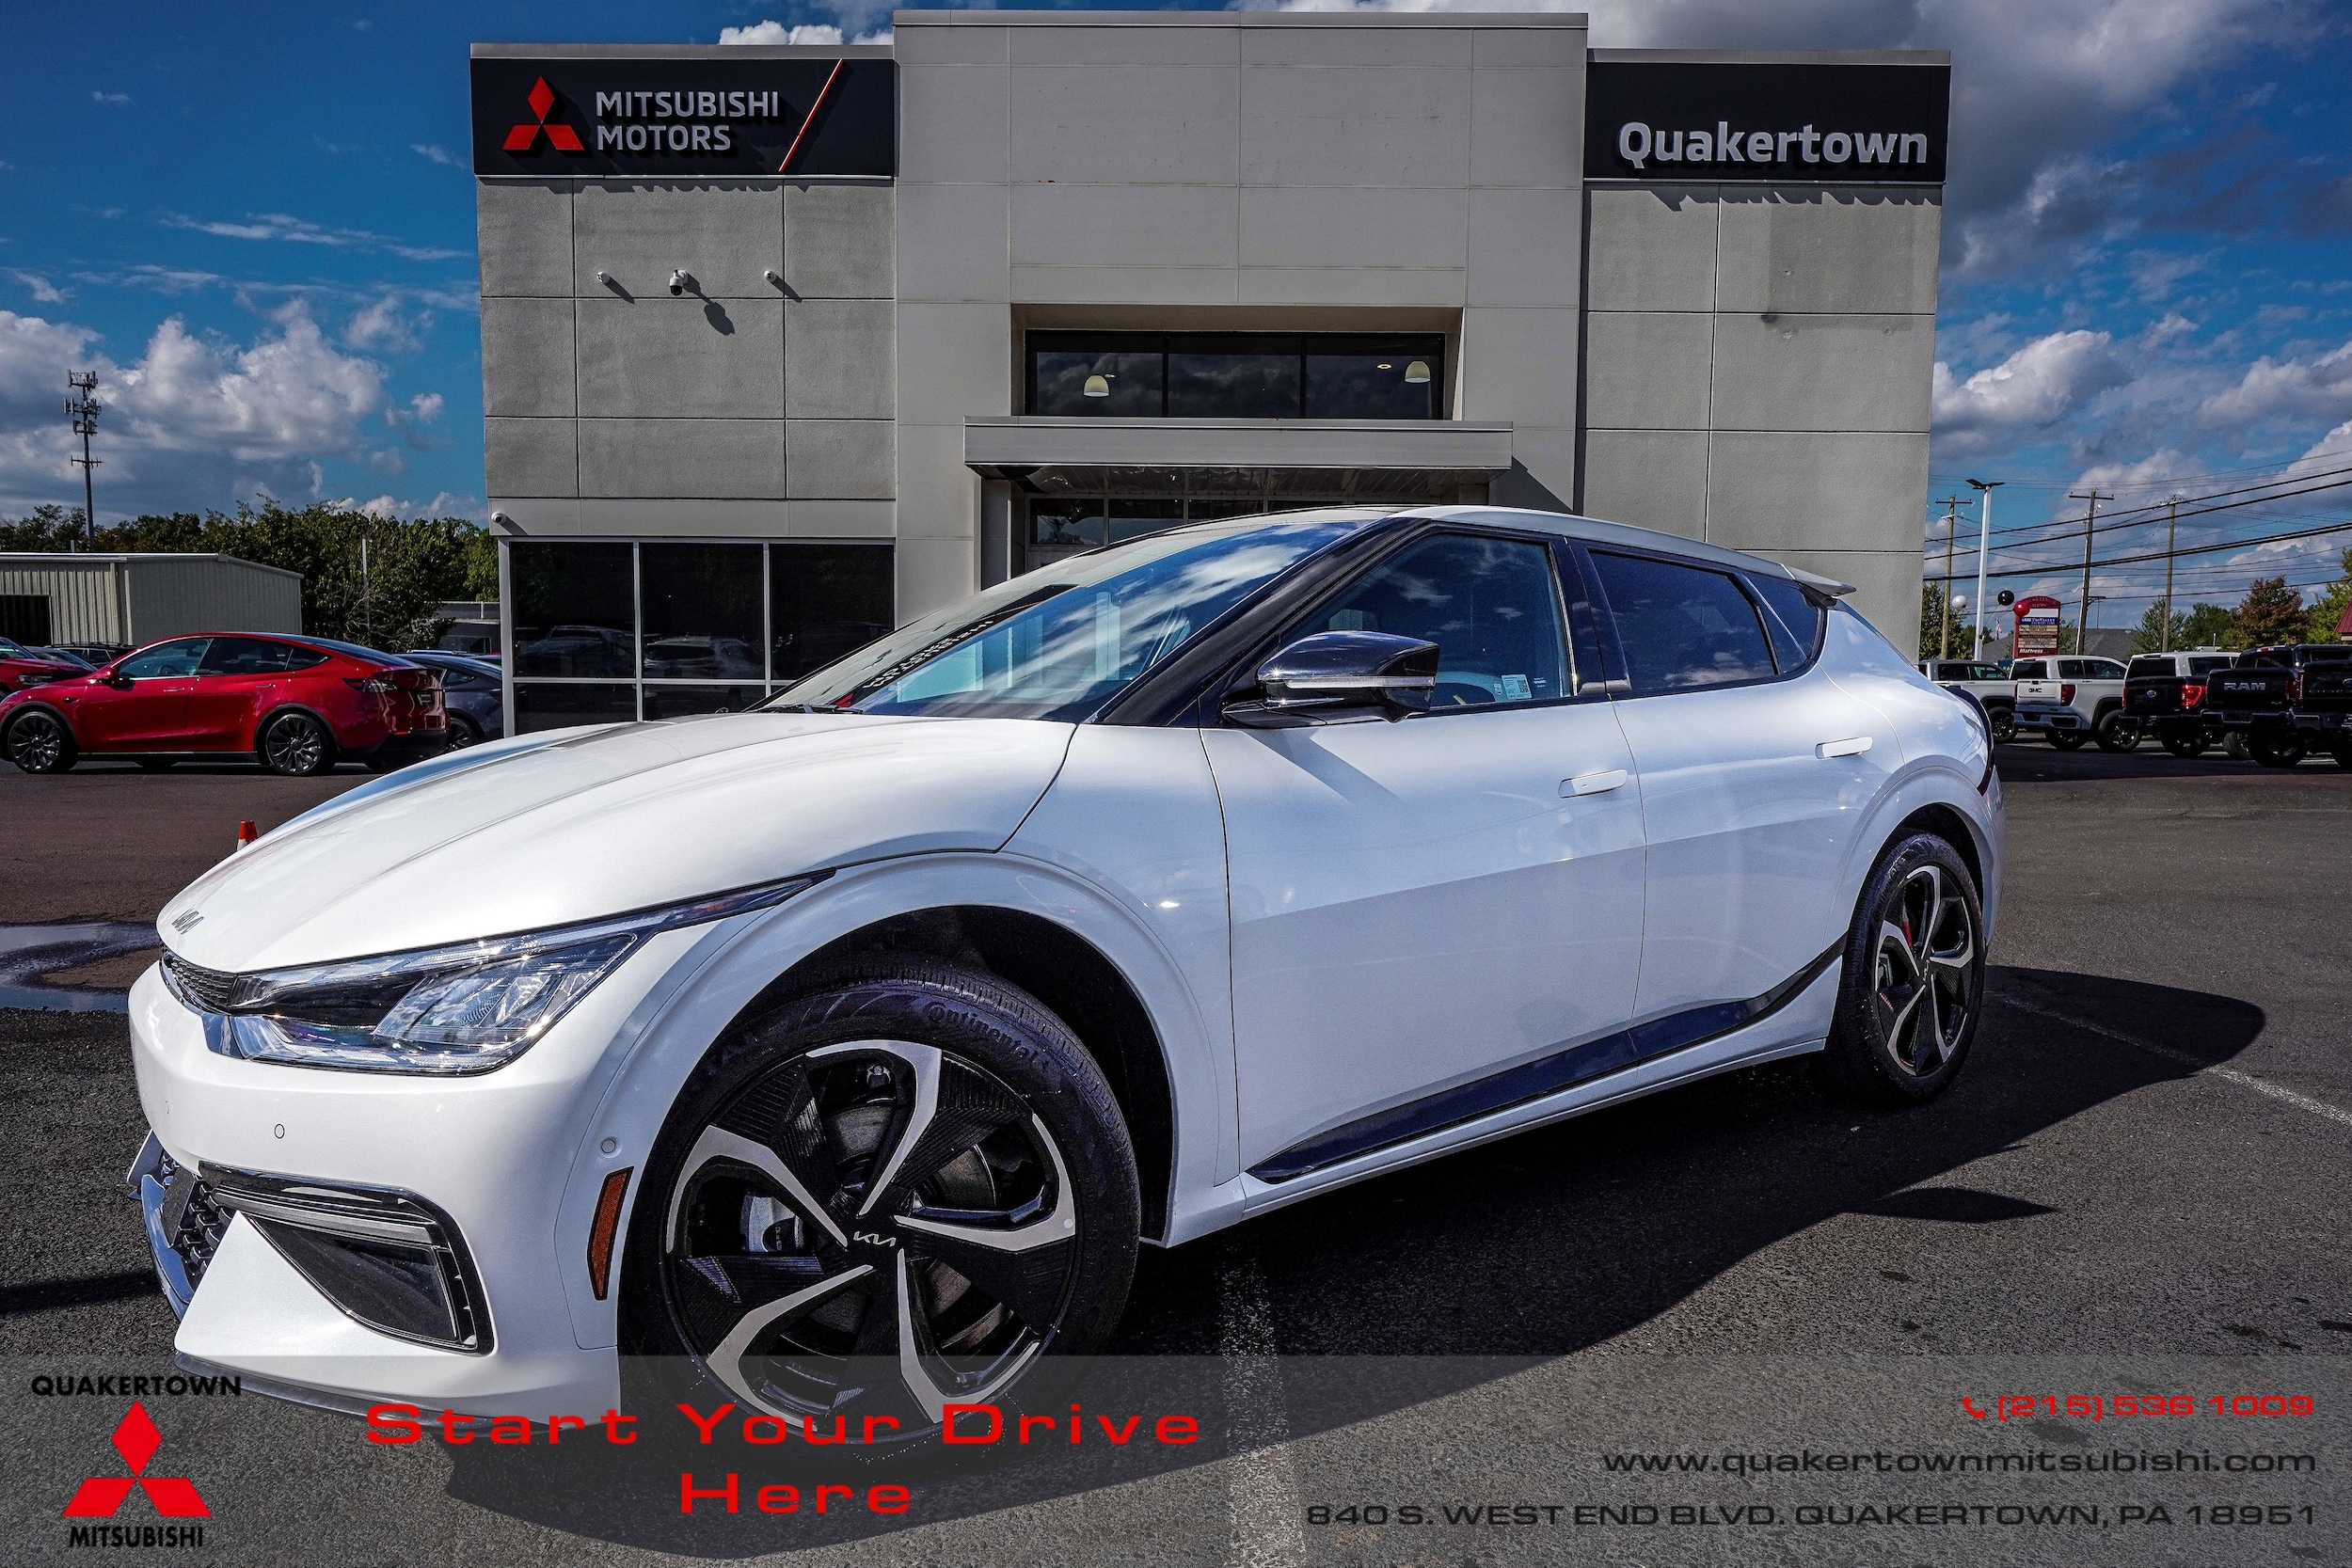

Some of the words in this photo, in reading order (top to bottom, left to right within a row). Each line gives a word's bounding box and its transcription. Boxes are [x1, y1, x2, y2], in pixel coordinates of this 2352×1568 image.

[596, 91, 778, 118] MITSUBISHI
[596, 125, 731, 150] MOTORS
[1619, 120, 1929, 169] Quakertown
[2223, 682, 2266, 691] RAM
